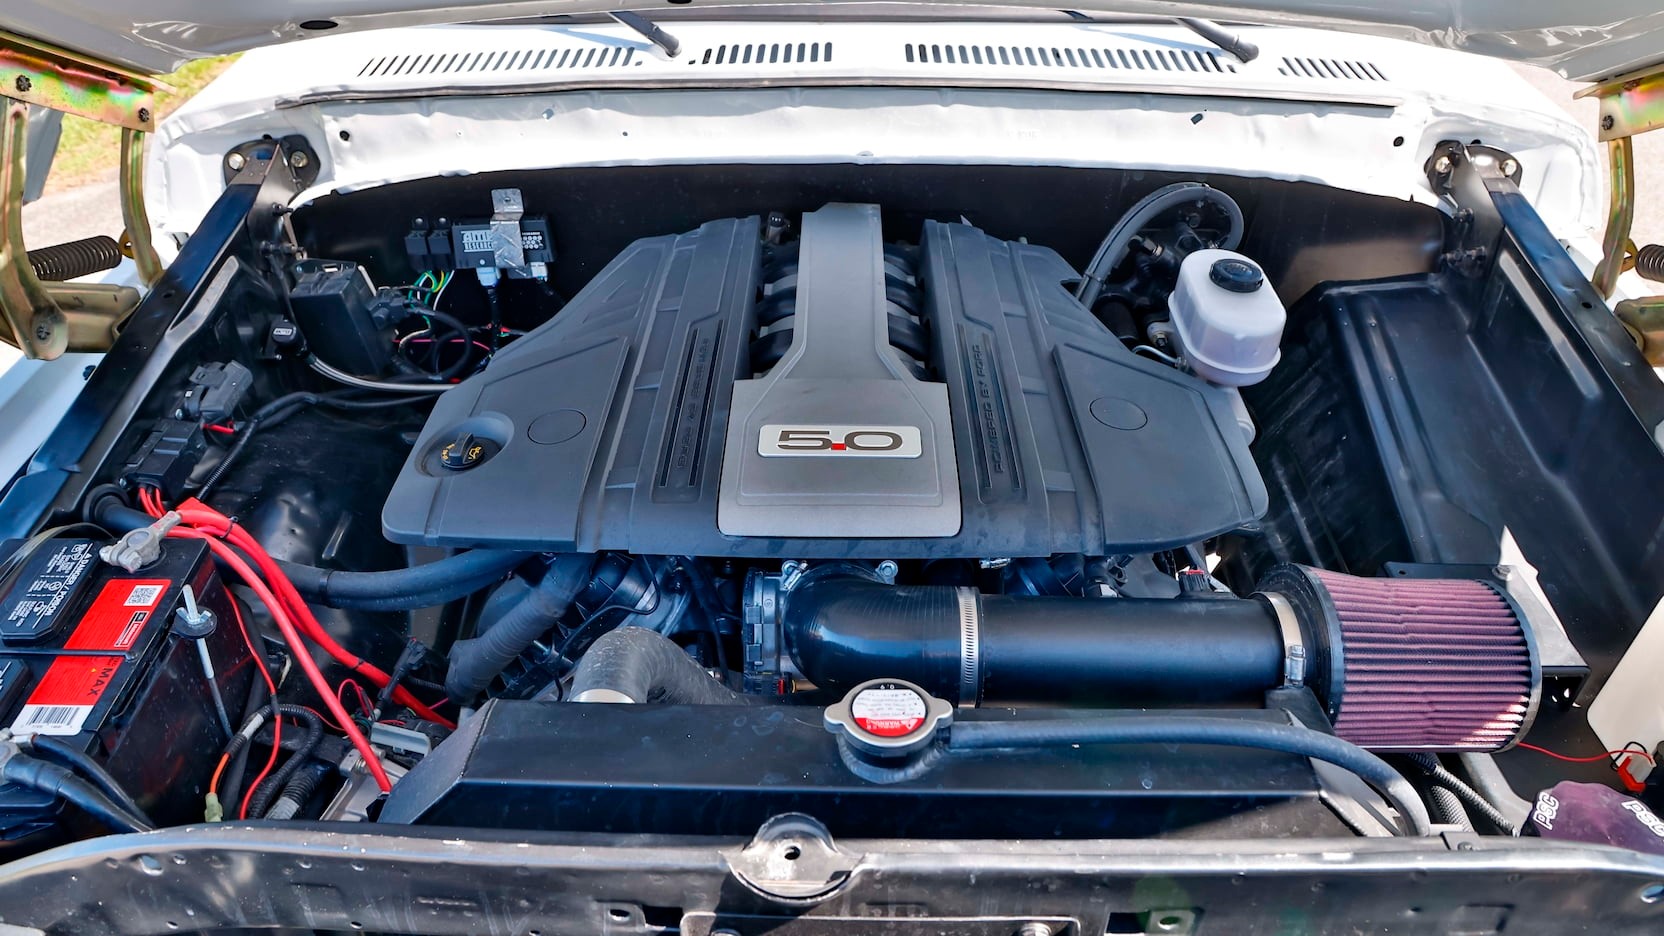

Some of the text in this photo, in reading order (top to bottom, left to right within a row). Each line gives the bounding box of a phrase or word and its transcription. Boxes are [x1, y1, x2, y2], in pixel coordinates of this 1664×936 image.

[464, 242, 494, 250] RESEARC
[972, 343, 1004, 474] POWERED BY FORD
[777, 430, 903, 451] 5.0
[87, 667, 113, 697] MAX
[1533, 791, 1560, 831] PSC
